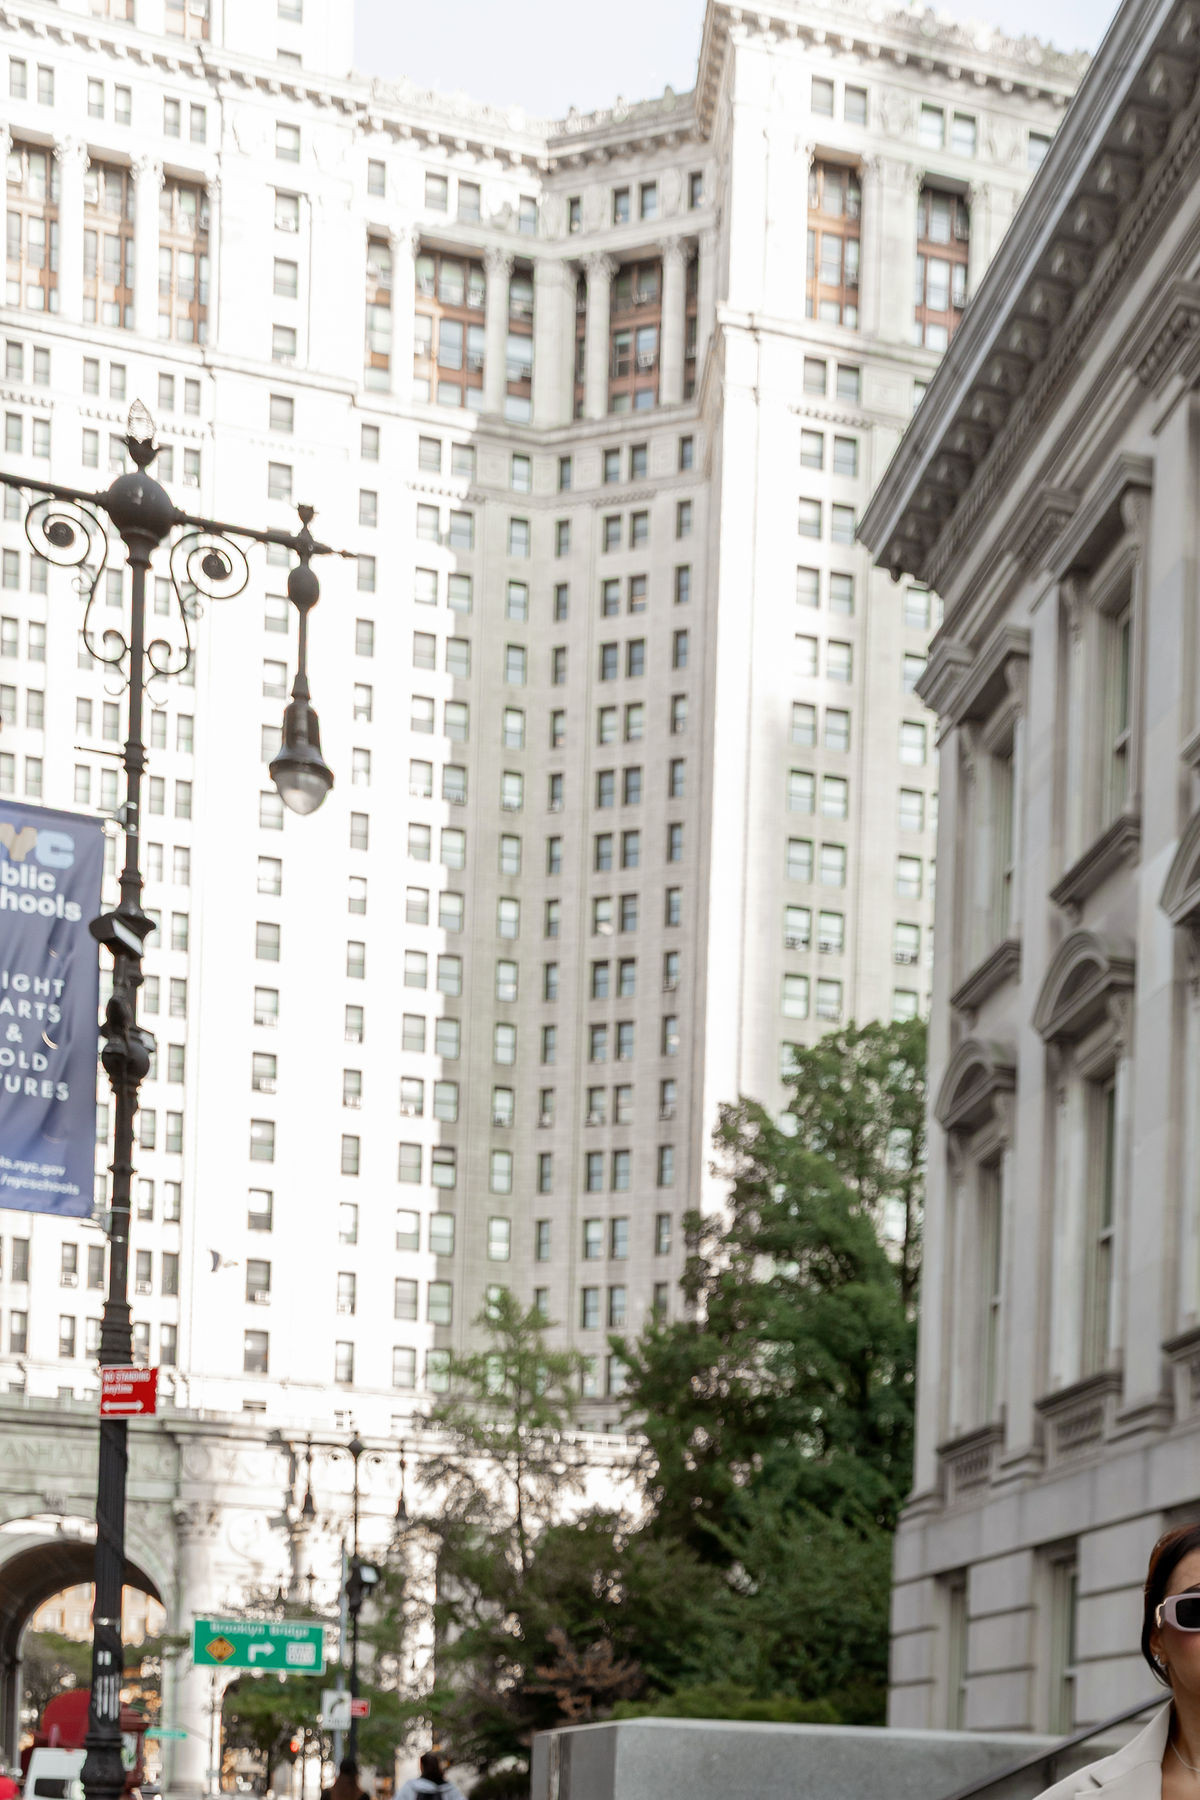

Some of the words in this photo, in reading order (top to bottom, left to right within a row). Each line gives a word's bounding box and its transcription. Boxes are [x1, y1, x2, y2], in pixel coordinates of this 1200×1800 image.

[0, 823, 75, 869] YC
[1, 859, 56, 892] blic
[0, 885, 82, 922] hools
[2, 970, 65, 998] IGHT
[0, 996, 61, 1023] ARTS
[6, 1022, 23, 1043] &
[0, 1047, 48, 1072] OLD
[0, 1073, 69, 1101] URES
[104, 1370, 114, 1383] NO
[210, 1622, 265, 1638] Brooklyn
[269, 1625, 309, 1640] Bridge
